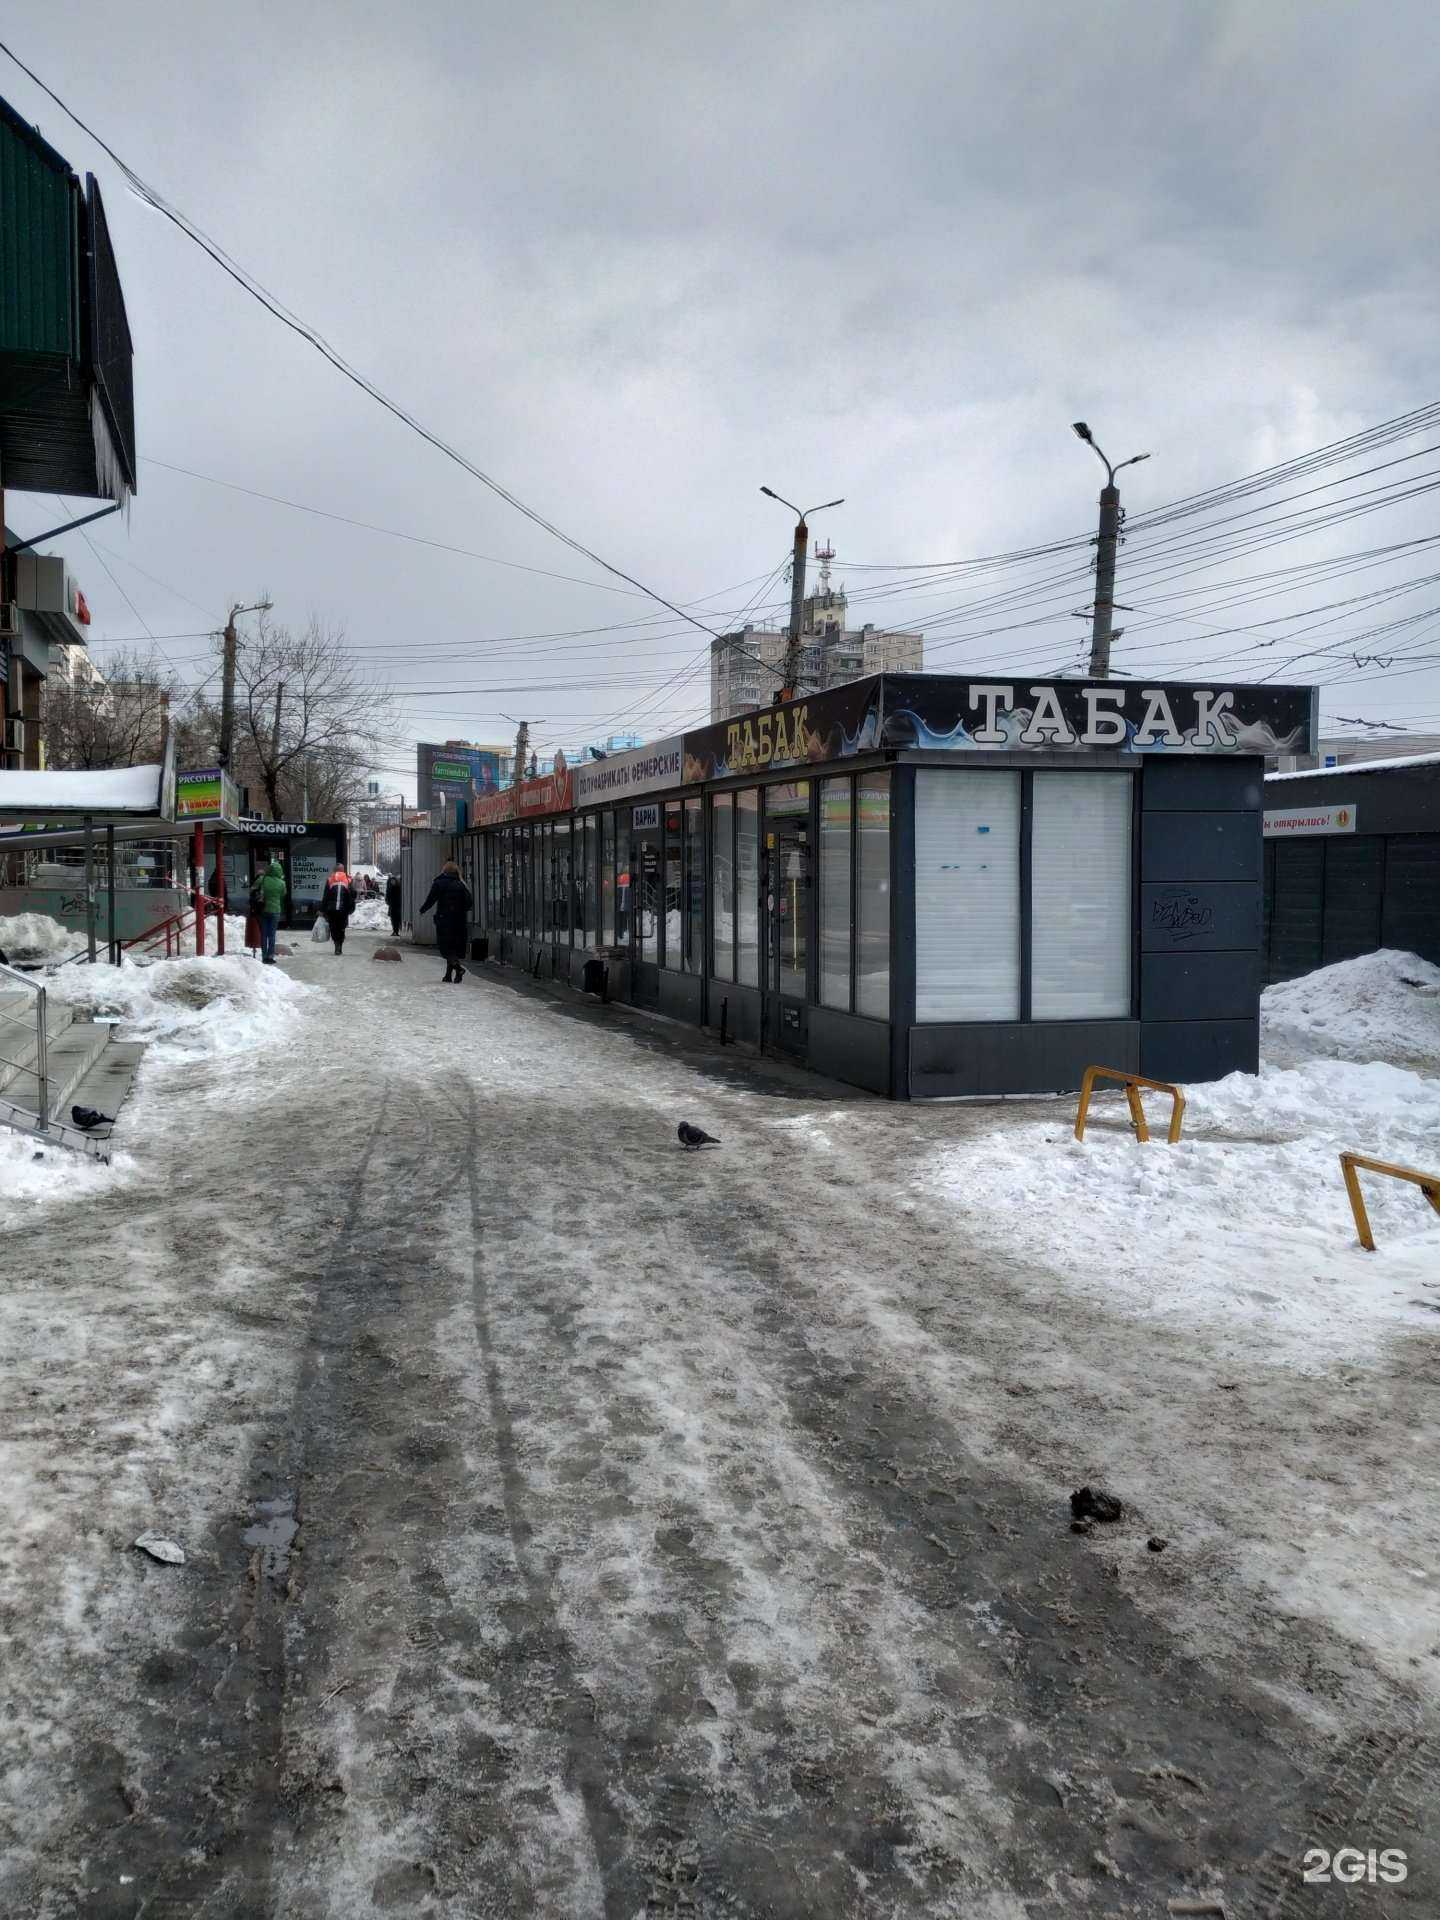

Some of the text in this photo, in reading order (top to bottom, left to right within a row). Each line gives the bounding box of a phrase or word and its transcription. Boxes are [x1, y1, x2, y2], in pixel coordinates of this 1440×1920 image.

[727, 704, 809, 769] ТАБАК
[968, 684, 1238, 747] ТАБАК
[579, 751, 680, 796] ПОЛУФАБРИКАТЫ ФЕРМЕРСКИЕ
[239, 822, 307, 834] NCOGNITO
[1273, 814, 1330, 829] открылись!
